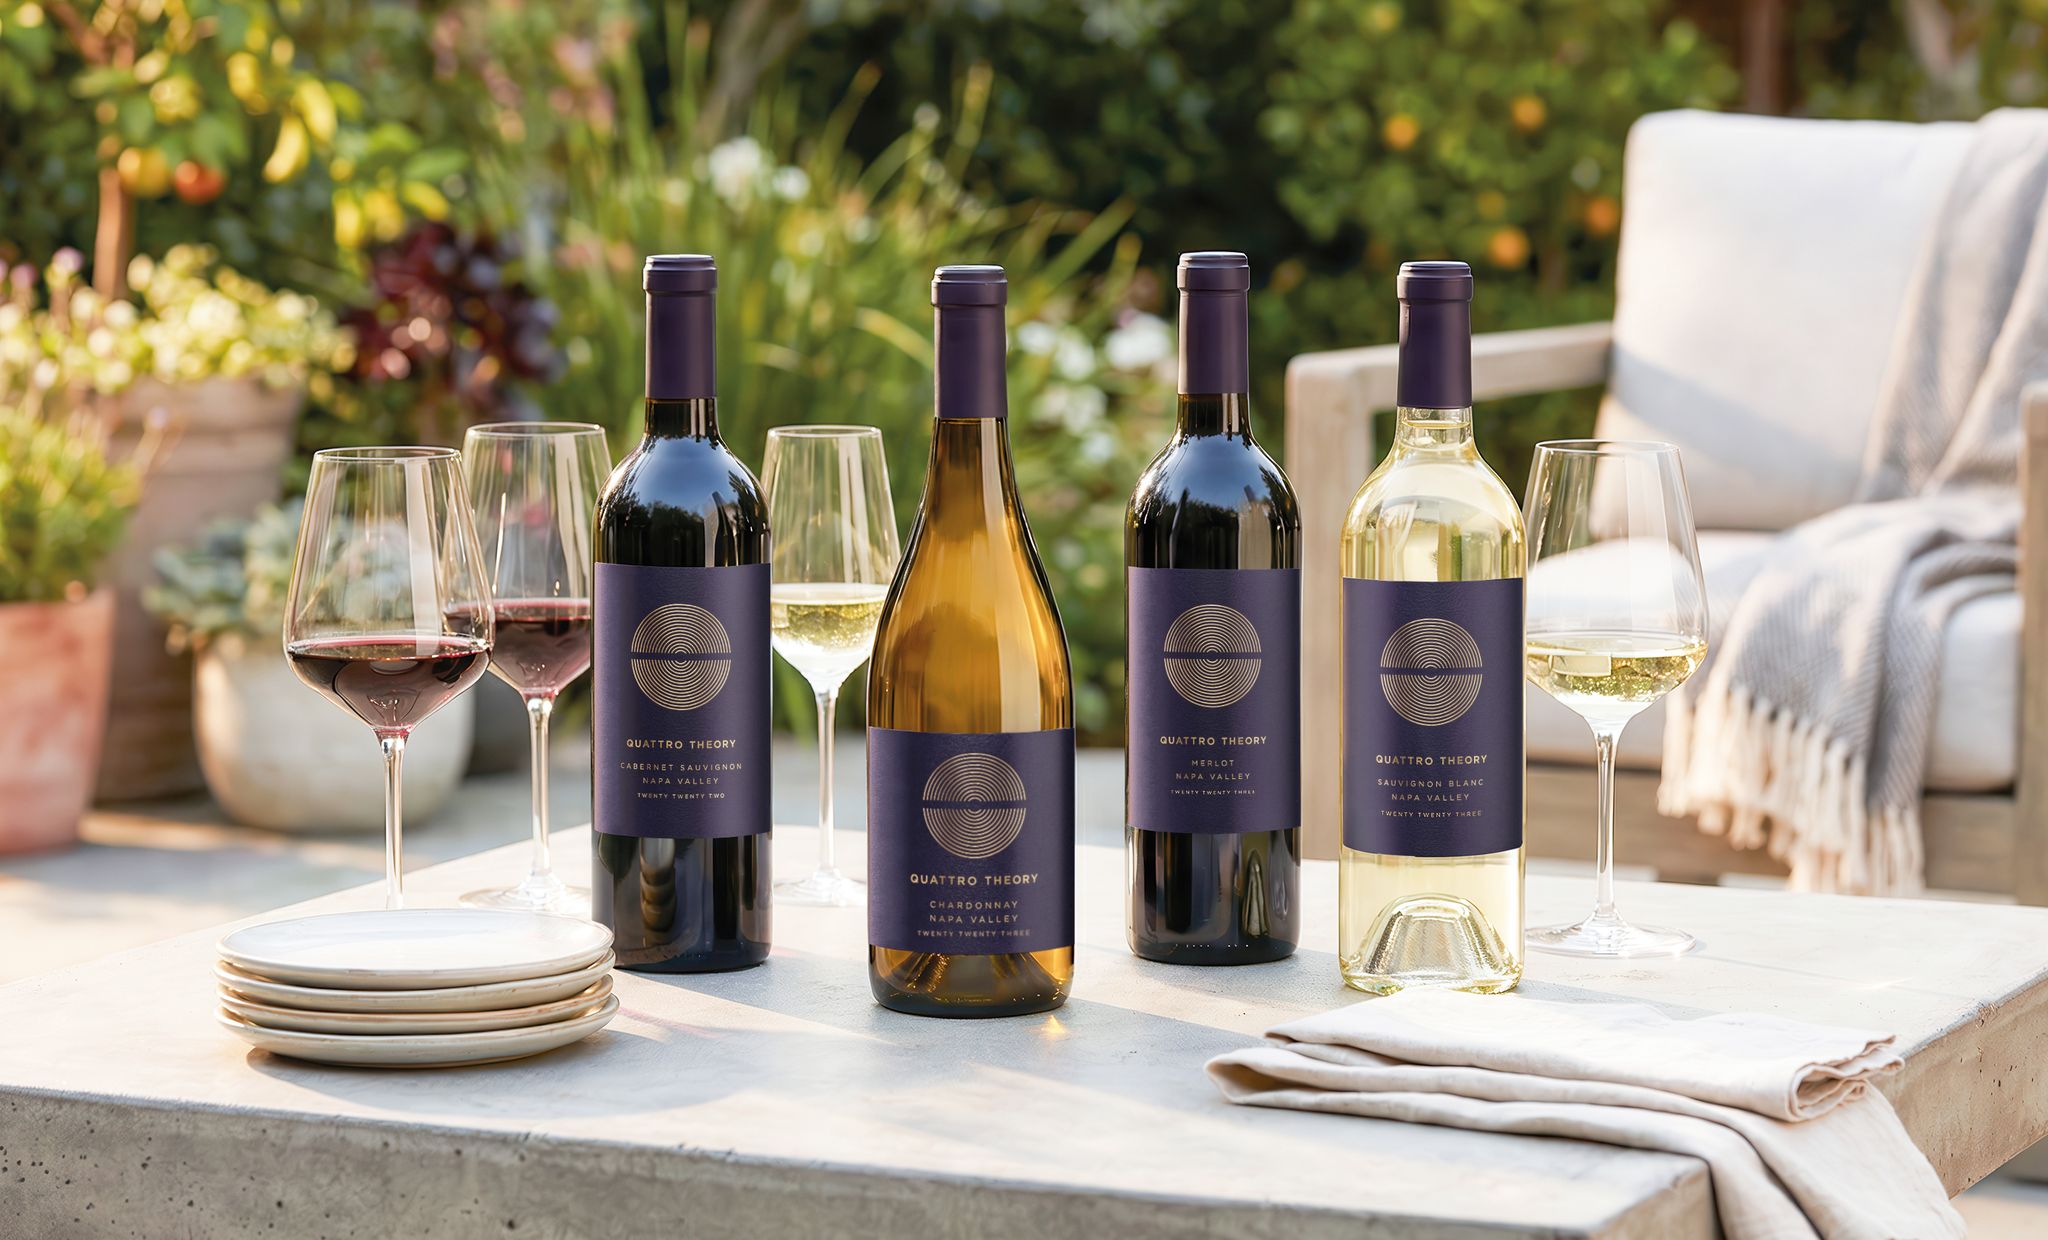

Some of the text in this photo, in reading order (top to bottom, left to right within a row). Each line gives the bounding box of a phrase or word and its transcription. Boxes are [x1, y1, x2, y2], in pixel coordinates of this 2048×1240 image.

[626, 738, 736, 750] QUATTRO THEORY
[1159, 735, 1267, 746] QUATTRO THEORY
[1191, 759, 1234, 767] MERLOT
[1375, 754, 1488, 766] QUATTRO THEORY
[620, 762, 742, 772] CABERNET SAUVIGNON
[642, 777, 719, 785] NAPA VALLEY
[1175, 772, 1250, 780] NAPA VALLEY
[1377, 778, 1484, 788] SAUVIGNON BLANC
[637, 792, 668, 800] TWENTY
[1391, 793, 1470, 802] NAPA VALLEY
[1380, 810, 1483, 819] TWENTY TWENTY THREE
[910, 873, 1039, 886] QUATTRO THEORY
[929, 900, 1018, 910] CHARDONNAY
[929, 914, 1018, 924] NAPA VALLEY
[917, 929, 1031, 938] TWENTY TWENTY THREE
